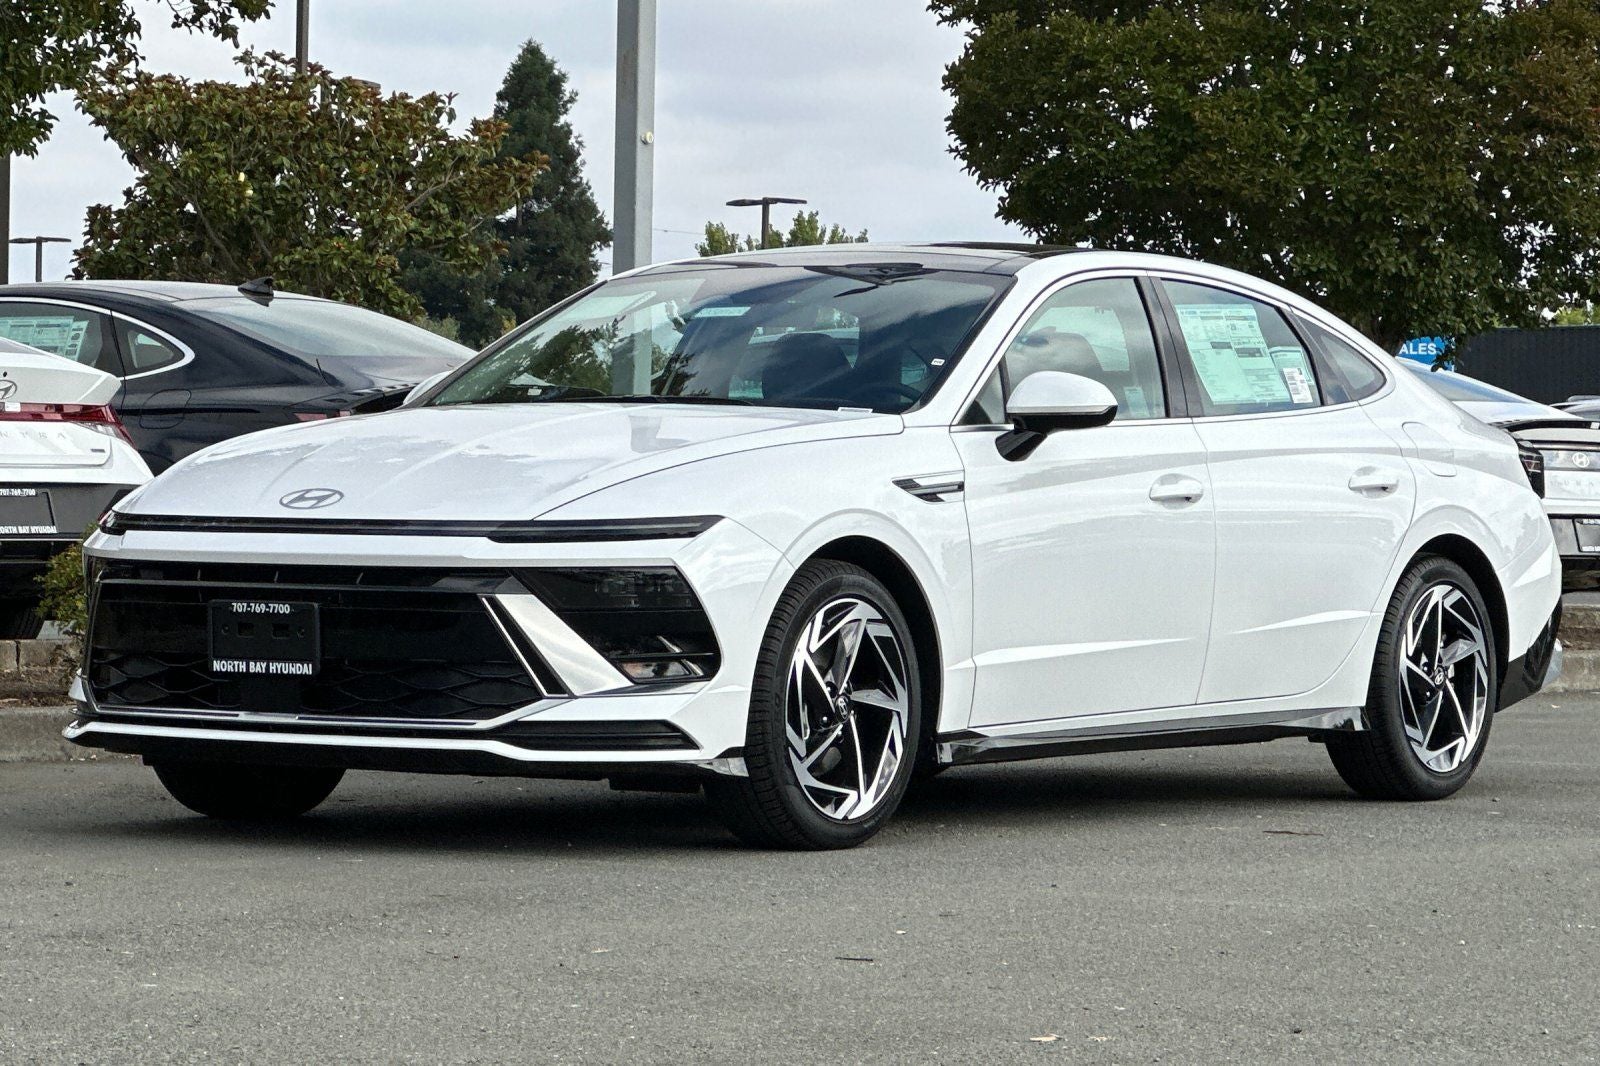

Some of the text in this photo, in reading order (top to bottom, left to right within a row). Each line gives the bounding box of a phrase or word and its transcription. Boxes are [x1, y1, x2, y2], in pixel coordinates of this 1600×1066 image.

[17, 525, 31, 534] BAY
[30, 525, 58, 534] HYUNDAI
[231, 602, 291, 614] 707-769-7700
[212, 660, 313, 675] NORTH BAY HYUNDAI
